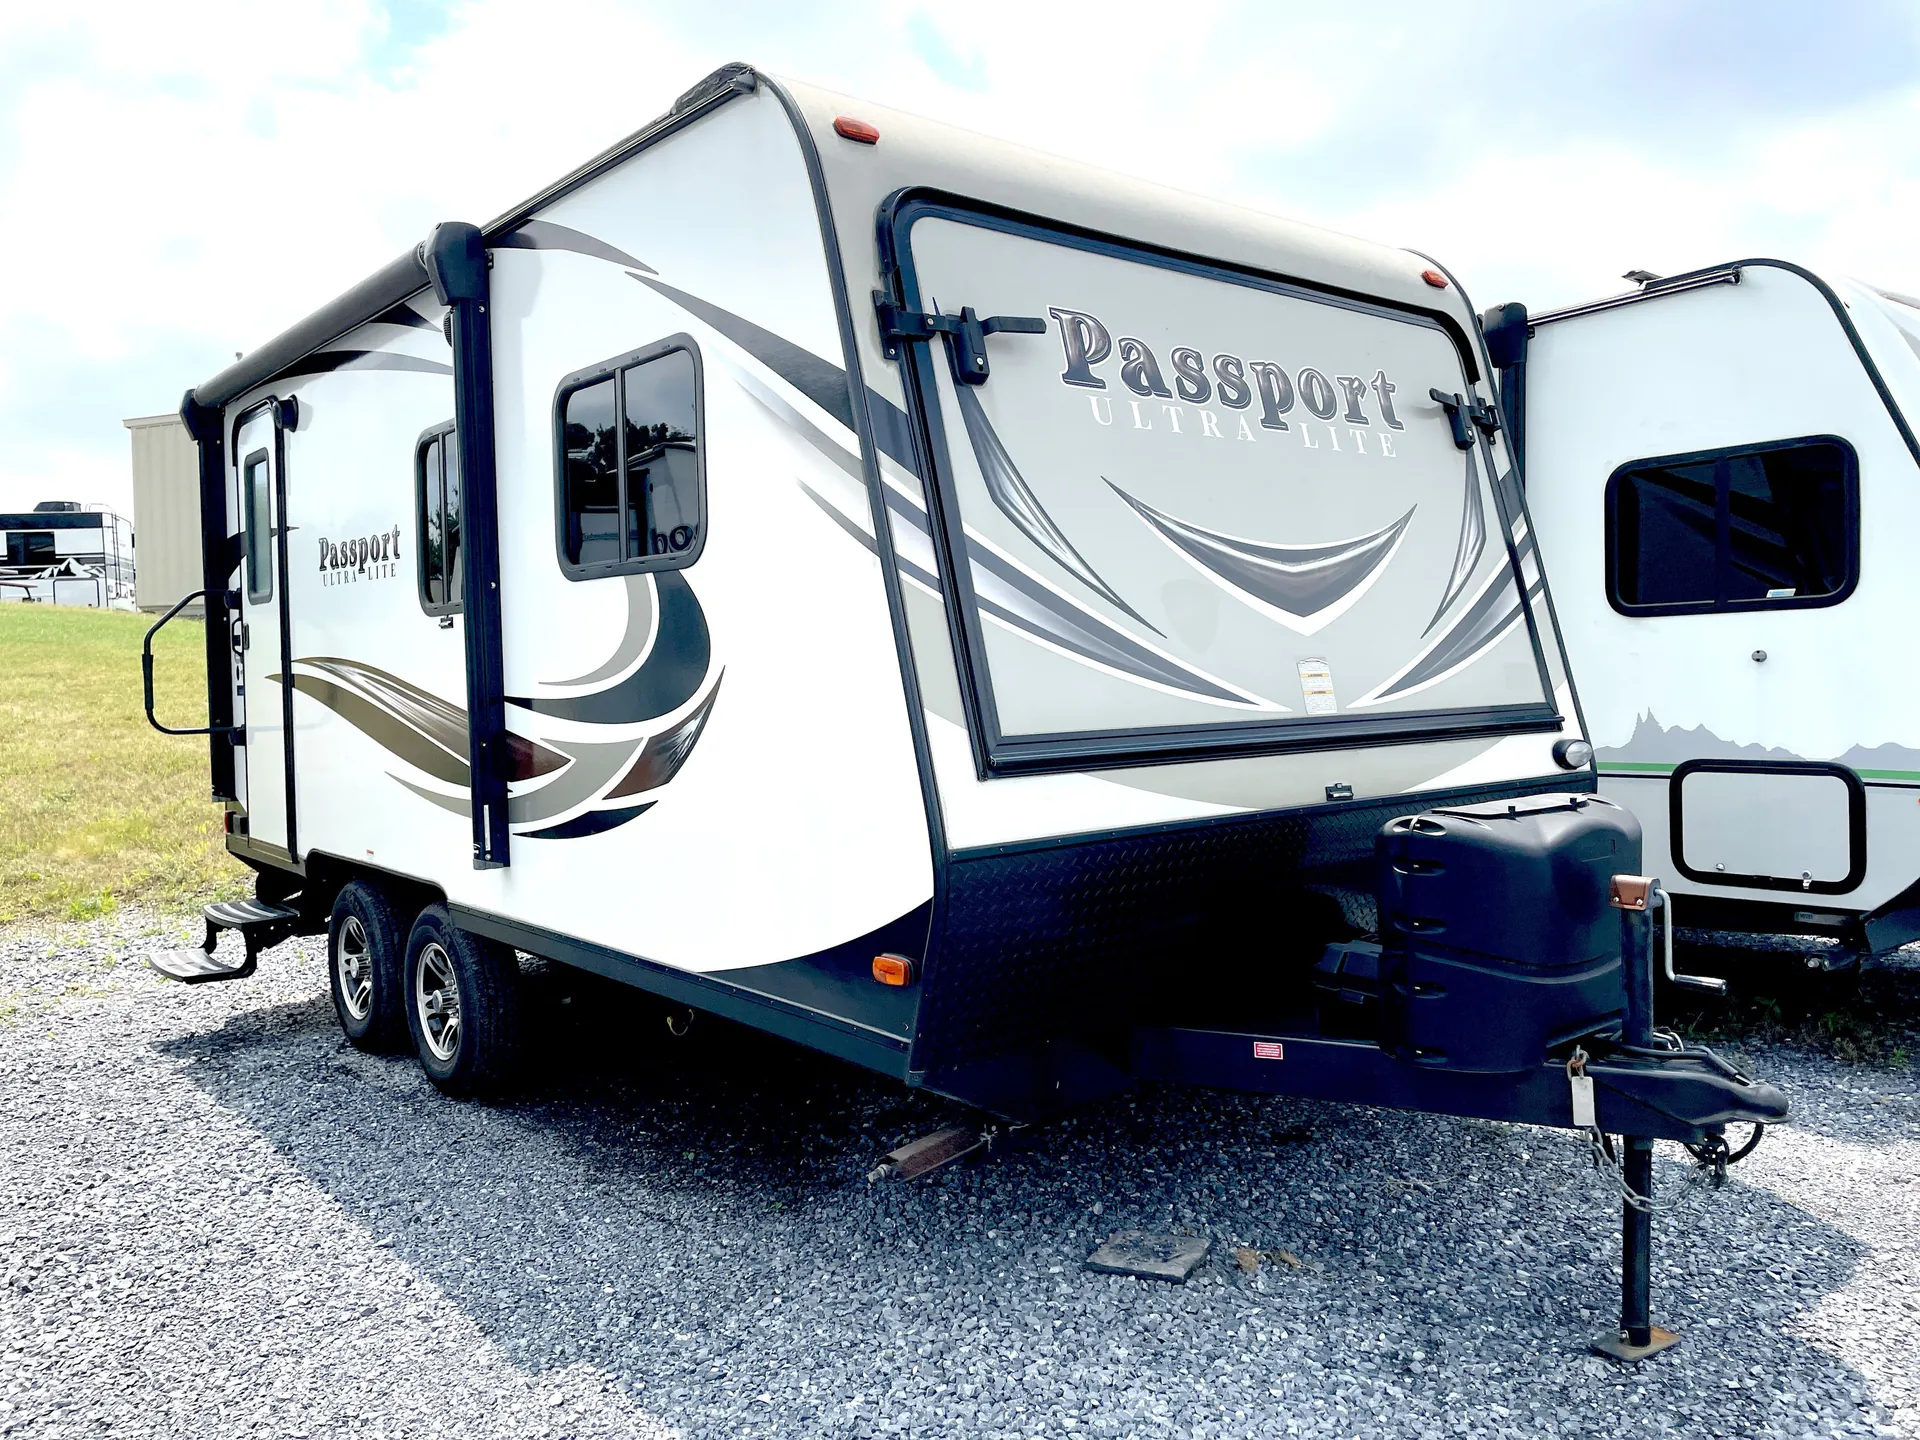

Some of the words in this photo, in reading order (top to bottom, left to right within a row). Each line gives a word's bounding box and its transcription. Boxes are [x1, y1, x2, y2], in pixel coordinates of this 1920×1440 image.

[1046, 304, 1405, 433] Passport
[1089, 395, 1257, 442] ULTRA
[1298, 422, 1397, 458] LITE
[318, 524, 401, 574] Passport
[322, 569, 357, 587] ULTRA
[368, 563, 397, 581] LITE
